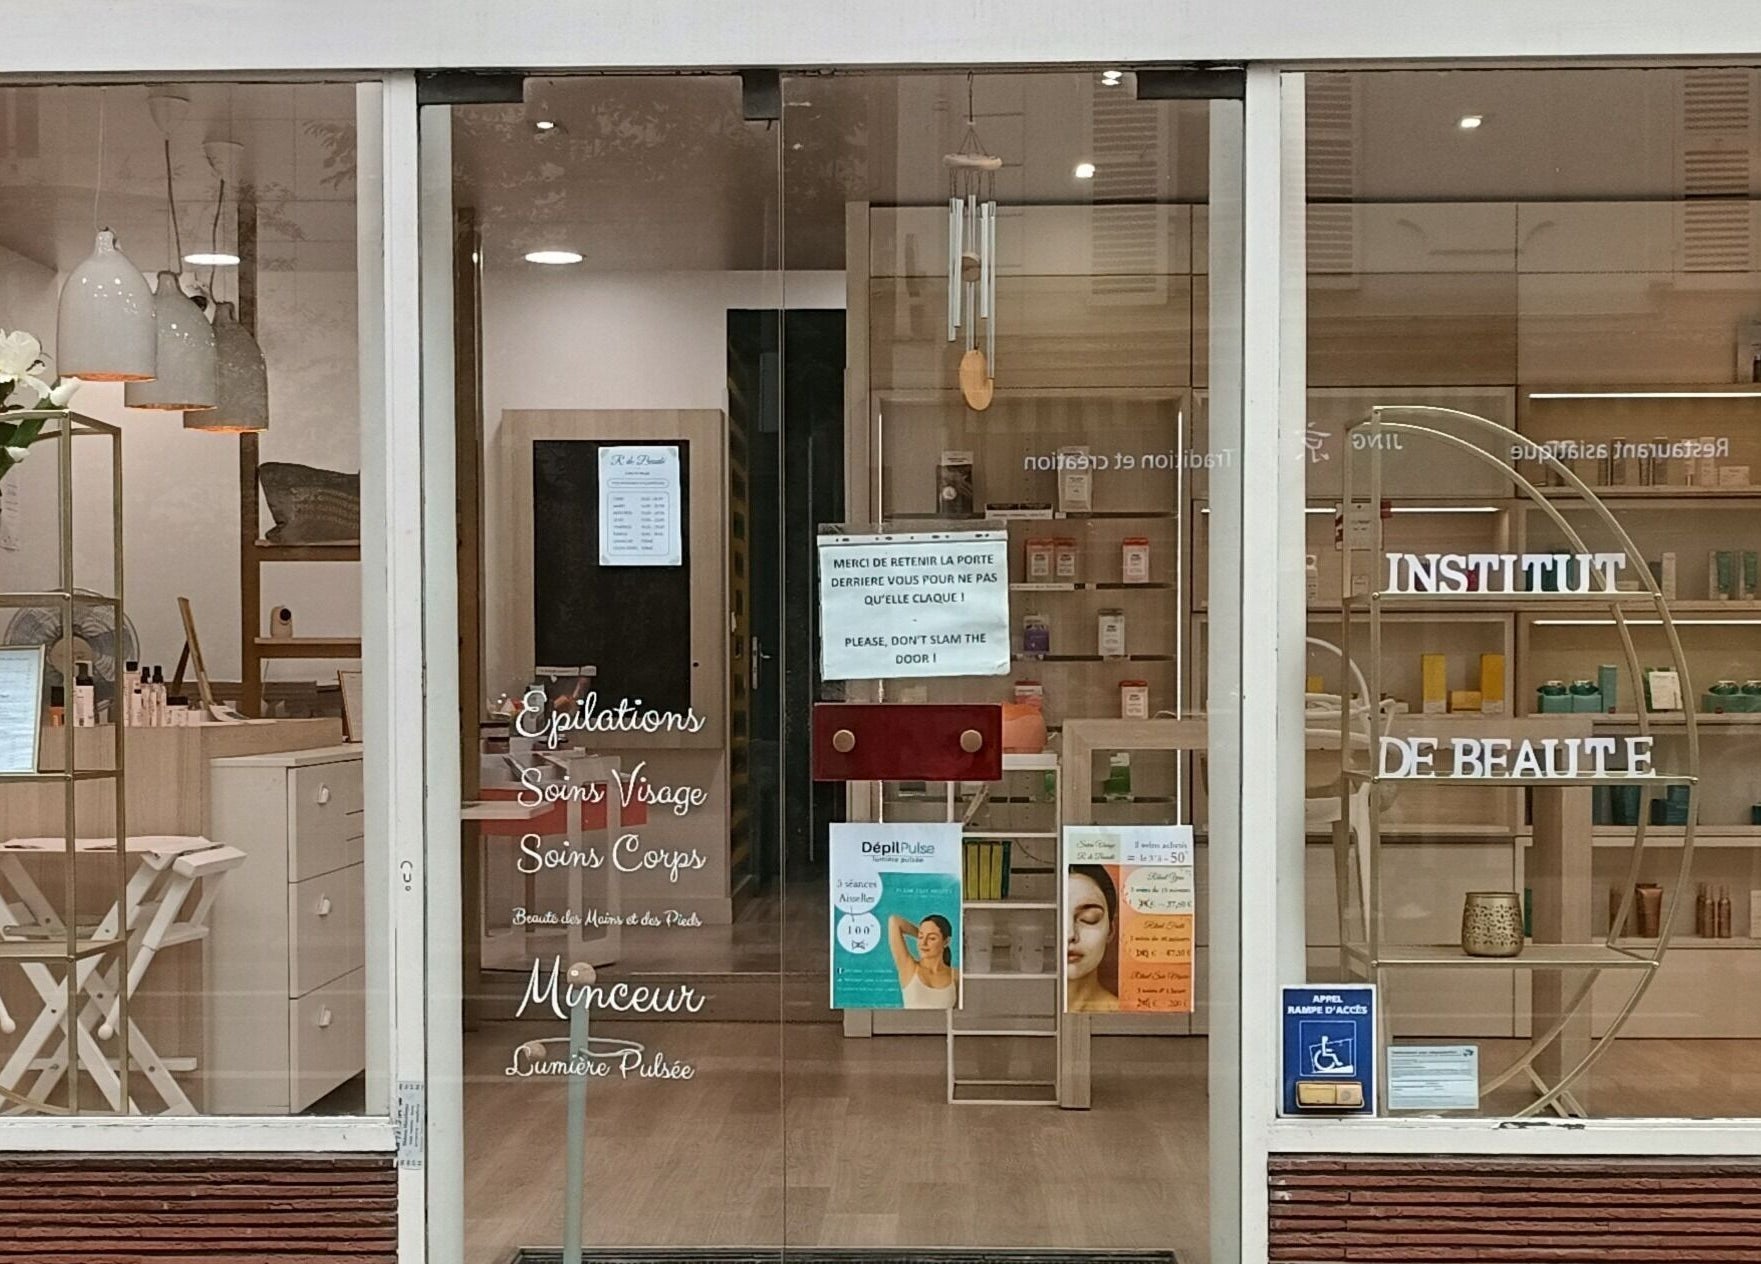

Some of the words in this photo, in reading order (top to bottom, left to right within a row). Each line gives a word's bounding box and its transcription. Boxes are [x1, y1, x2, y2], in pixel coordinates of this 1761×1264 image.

[833, 558, 869, 569] MERCI
[872, 557, 888, 568] DE
[890, 556, 938, 567] RETENIR
[940, 555, 954, 566] LA
[957, 554, 994, 565] PORTE
[1385, 552, 1626, 593] INSTITUT
[831, 575, 885, 588] DERRIERE
[888, 574, 919, 586] VOUS
[922, 573, 955, 585] POUR
[958, 573, 973, 584] NE
[976, 572, 998, 583] PAS
[864, 594, 909, 606] QU'ELLE
[912, 592, 958, 604] CLAQUE
[845, 636, 888, 648] PLEASE,
[891, 635, 927, 646] DON'T
[930, 634, 962, 645] SLAM
[965, 633, 987, 644] THE
[895, 654, 930, 665] DOOR
[515, 690, 707, 749] Epilations
[1378, 736, 1438, 779] DE
[1450, 736, 1657, 779] BEAUTE
[518, 767, 605, 807] Soins
[611, 761, 708, 816] Visage
[517, 834, 604, 873] Soins
[612, 834, 707, 883] Corps
[561, 909, 582, 925] des
[585, 908, 624, 927] Mains
[626, 911, 639, 925] et
[640, 911, 662, 926] des
[663, 909, 702, 927] Pieds
[515, 954, 707, 1020] Minceur
[1287, 1005, 1323, 1015] RAMPE
[505, 1045, 611, 1077] Lumière
[619, 1049, 696, 1079] Pulsée
